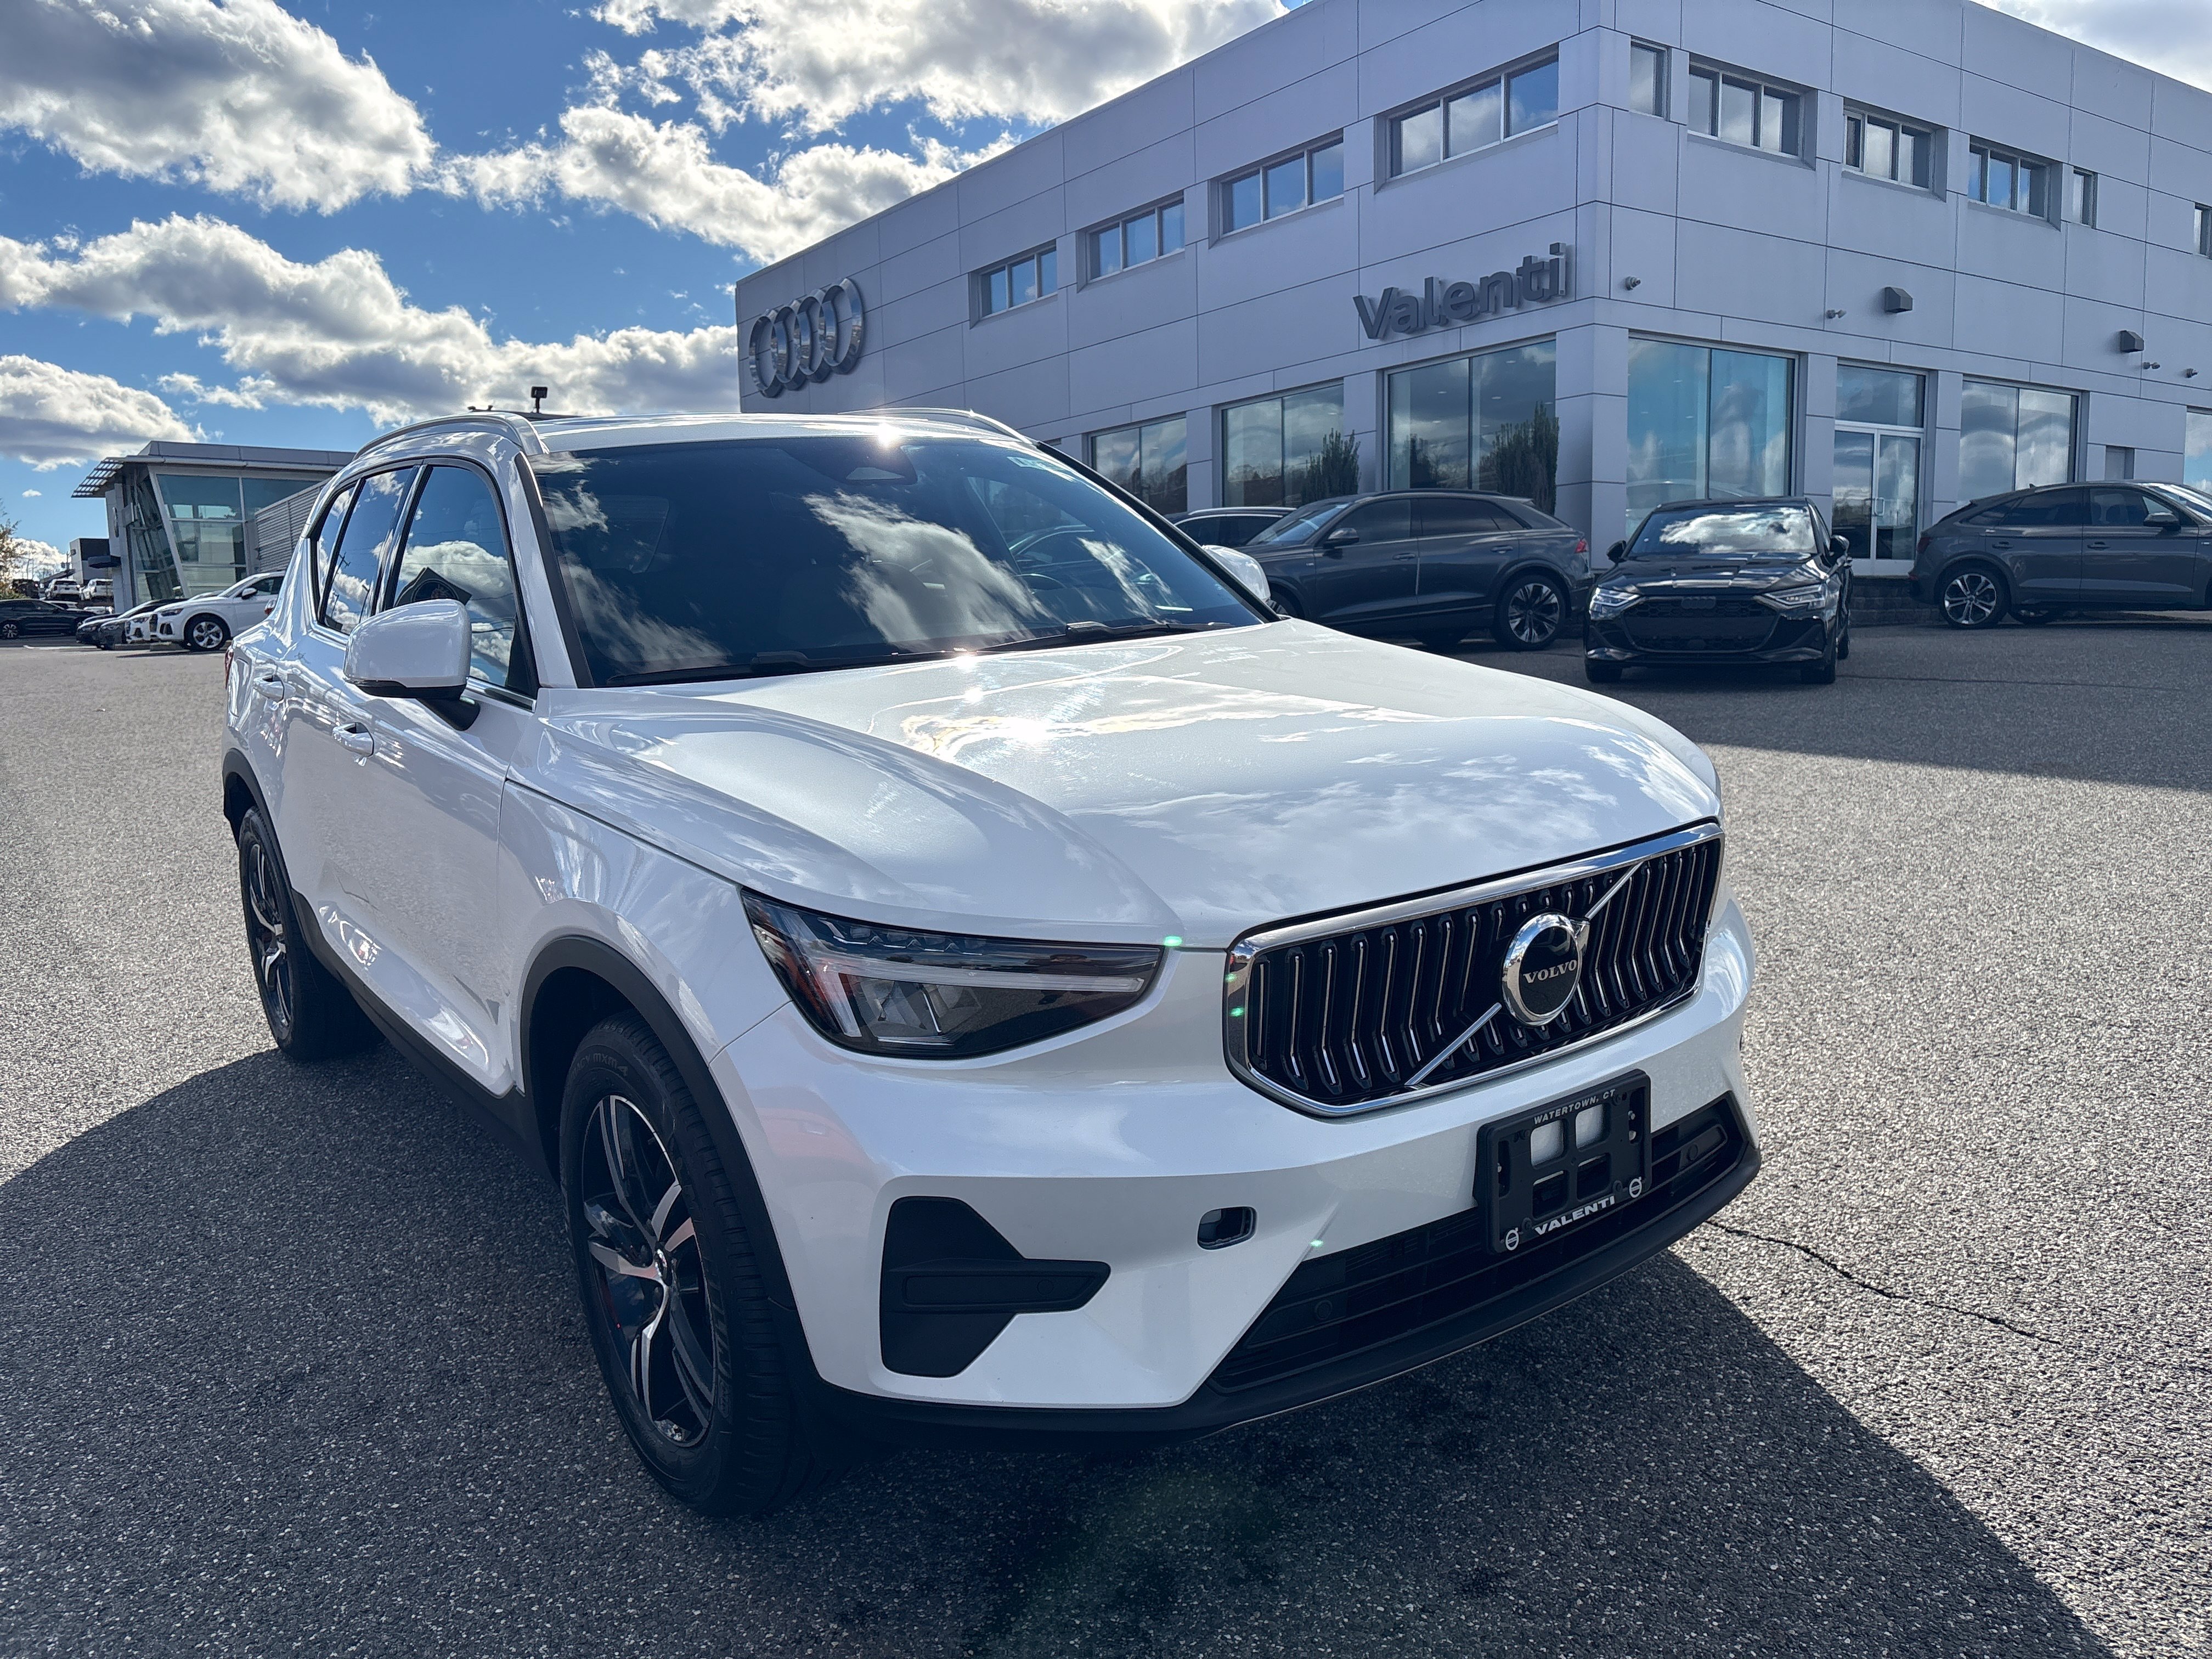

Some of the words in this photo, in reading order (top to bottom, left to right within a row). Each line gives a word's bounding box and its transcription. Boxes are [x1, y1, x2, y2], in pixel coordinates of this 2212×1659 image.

[1353, 242, 1566, 340] Valenti
[1523, 960, 1577, 984] VOLVO
[1534, 1096, 1599, 1124] WATERTOWN,
[1602, 1089, 1616, 1099] CT
[1534, 1195, 1616, 1235] VALENTI
